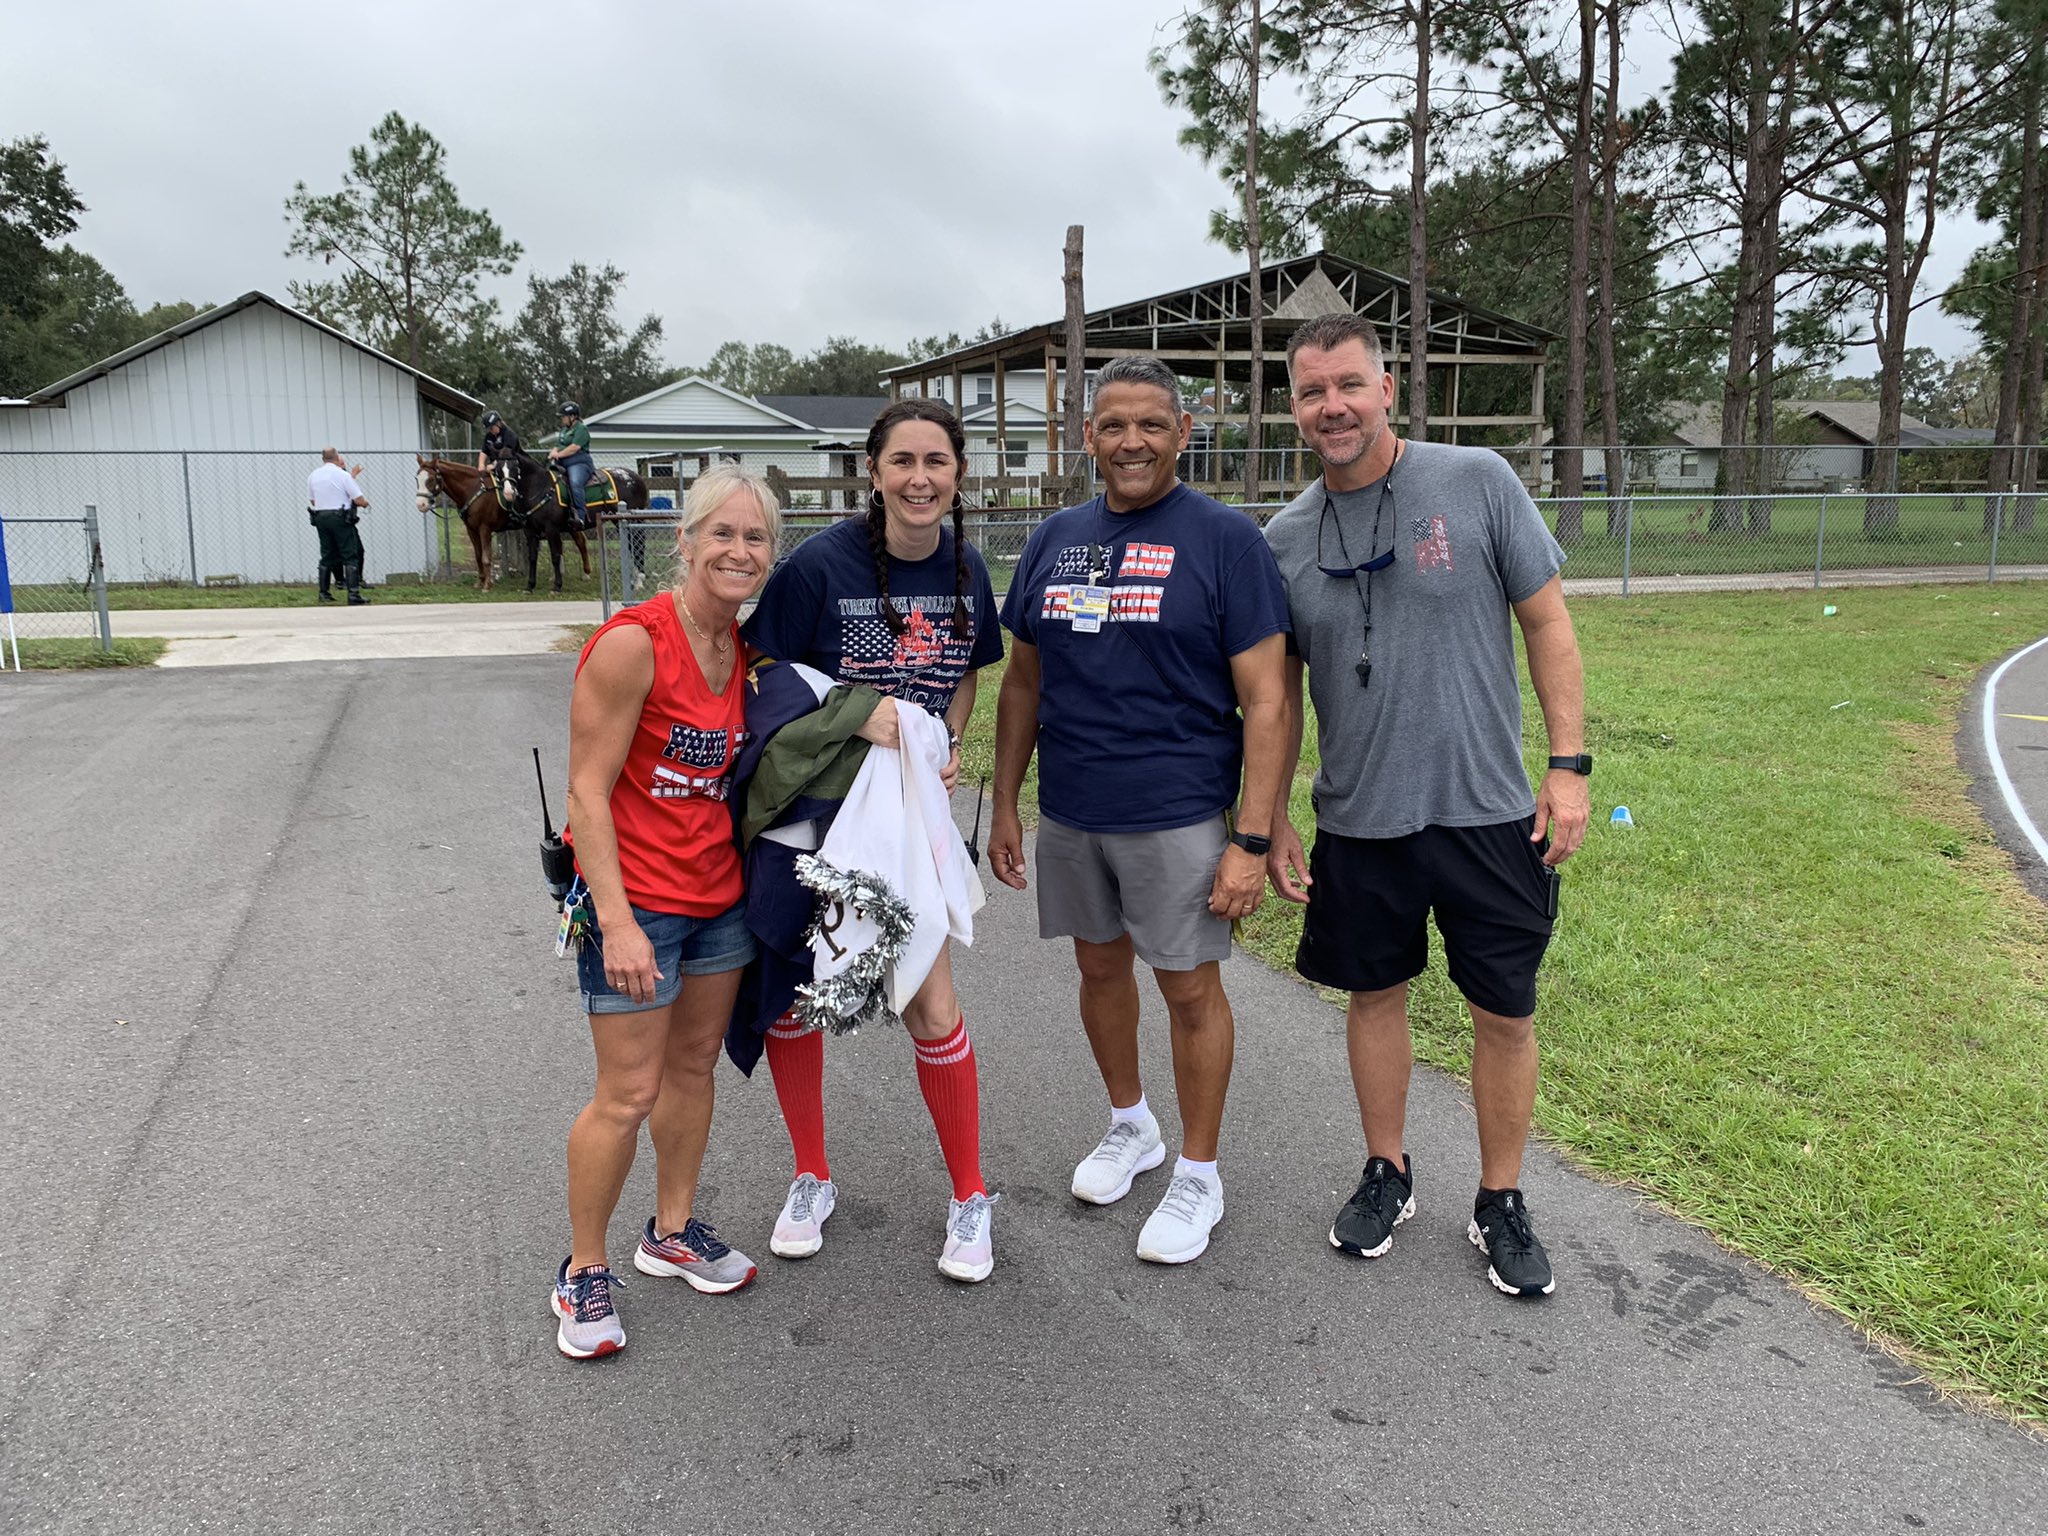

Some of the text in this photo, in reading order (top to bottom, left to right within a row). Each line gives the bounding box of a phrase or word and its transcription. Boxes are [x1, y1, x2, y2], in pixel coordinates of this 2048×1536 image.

[1118, 542, 1176, 578] AND
[838, 598, 877, 616] TURKEY
[878, 596, 909, 615] CEEK
[910, 595, 944, 613] MIDDLE
